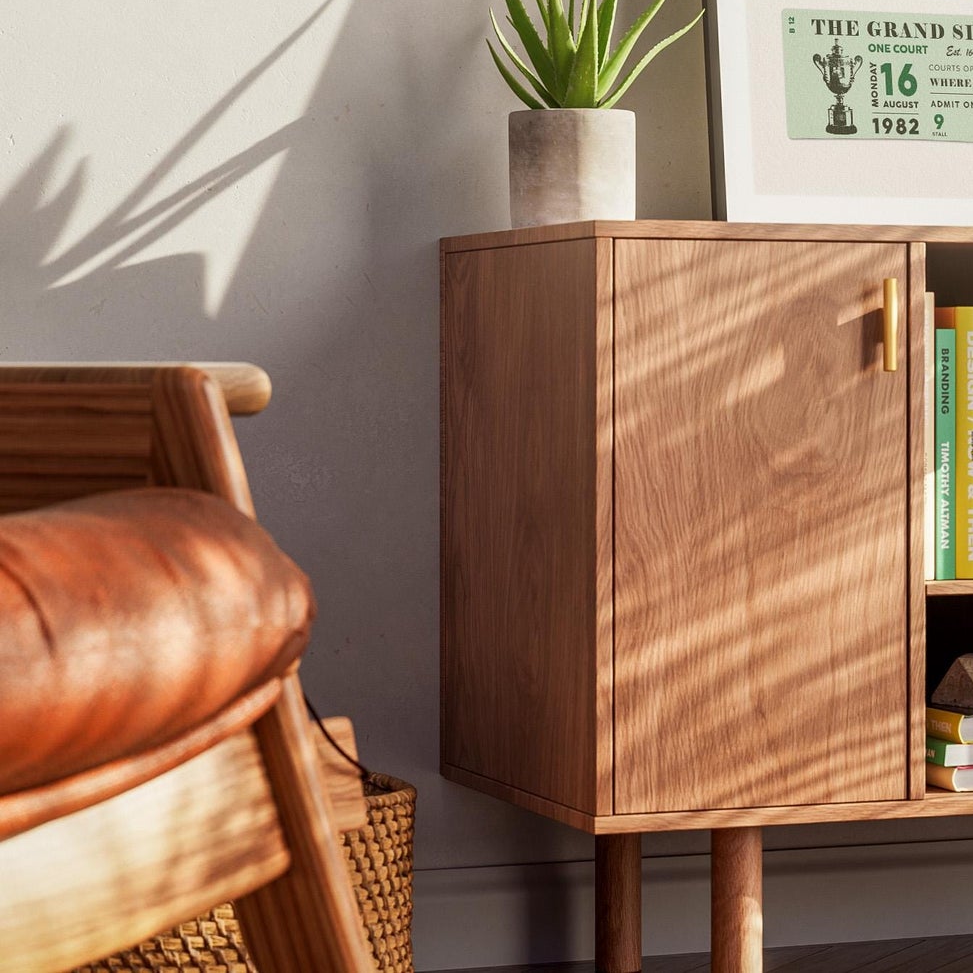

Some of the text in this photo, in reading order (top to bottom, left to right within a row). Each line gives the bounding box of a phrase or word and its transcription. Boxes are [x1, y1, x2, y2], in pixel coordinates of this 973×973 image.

[788, 16, 795, 25] 12
[811, 18, 860, 37] THE
[867, 20, 945, 40] GRAND
[868, 43, 929, 55] ONE COURT
[928, 63, 961, 72] COURTS
[869, 62, 879, 108] MONDAY
[880, 62, 918, 97] 16
[929, 78, 973, 88] WHERE
[883, 100, 919, 109] AUGUST
[930, 100, 960, 108] ADMIT
[872, 117, 920, 135] 1982
[933, 113, 945, 130] 9
[941, 348, 950, 415] BRANDING
[940, 441, 950, 549] TIMOTHY ALTMAN
[931, 720, 952, 734] THEN
